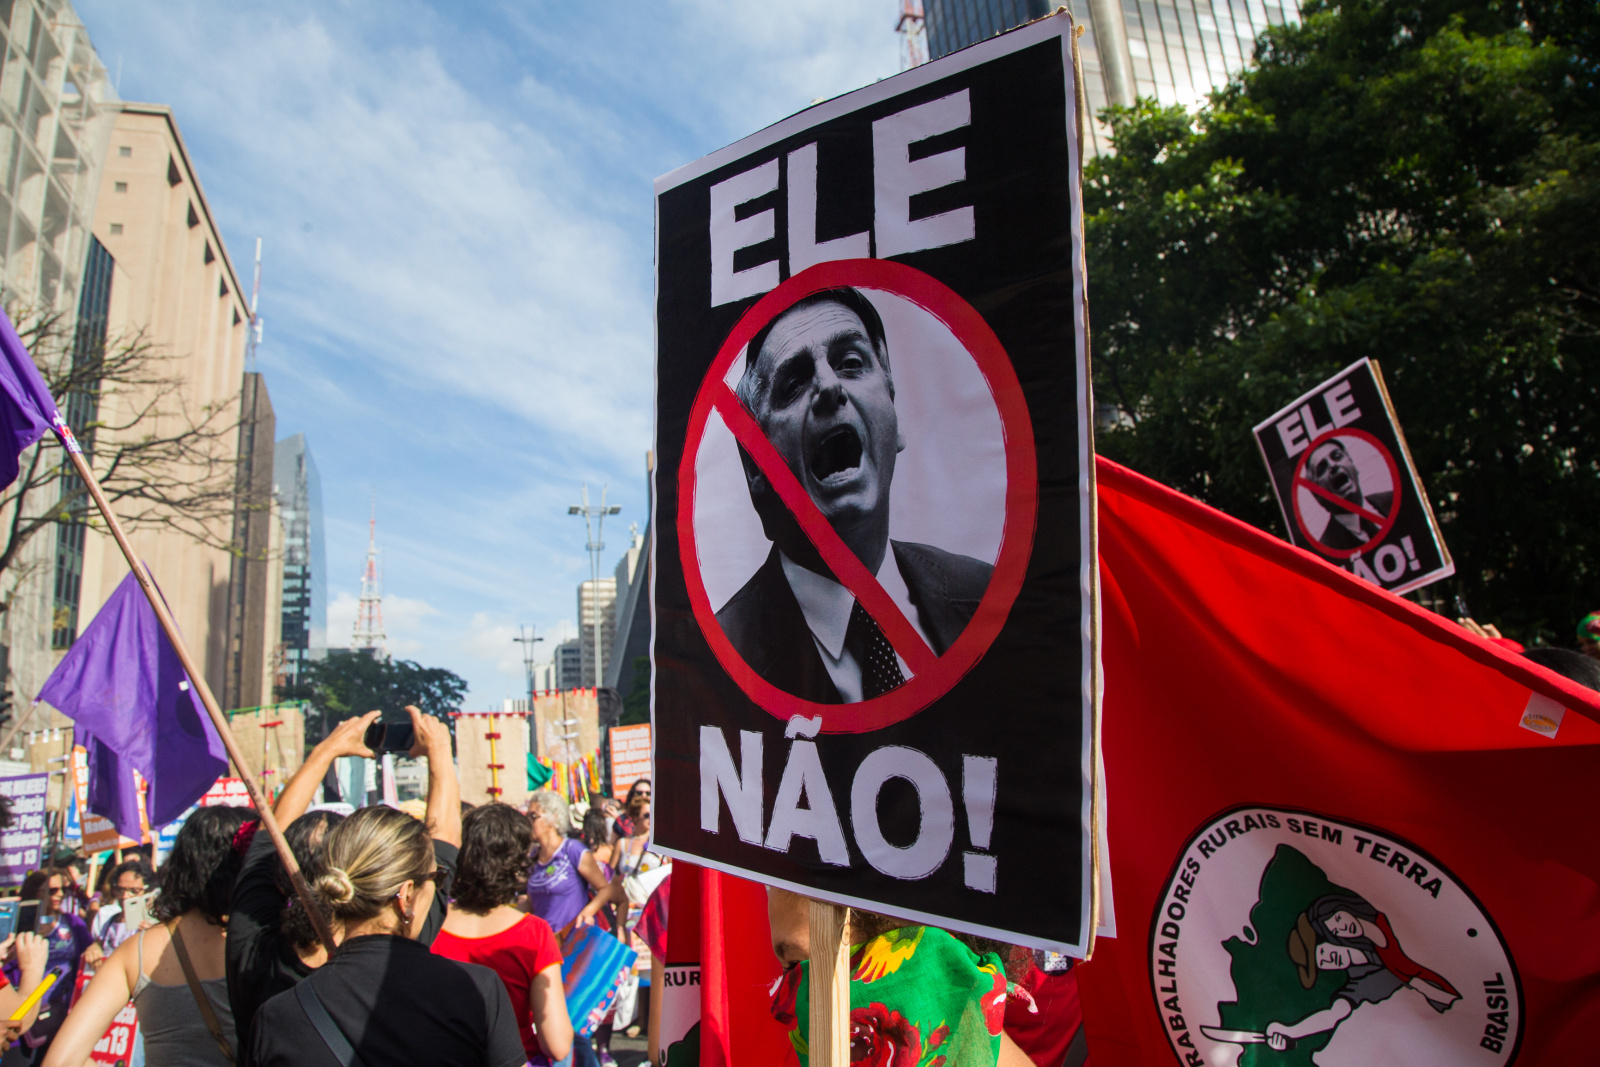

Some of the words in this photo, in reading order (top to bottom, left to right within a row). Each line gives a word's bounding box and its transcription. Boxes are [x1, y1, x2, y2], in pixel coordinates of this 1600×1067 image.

[710, 87, 976, 308] ELE
[1275, 379, 1362, 459] ELE
[1339, 535, 1421, 587] ÃO!
[84, 818, 116, 835] Hadd
[699, 714, 998, 895] NÃO!
[664, 970, 701, 988] RUR
[1158, 857, 1205, 1067] RABALHADORES
[1197, 813, 1281, 859] RURAIS
[1286, 818, 1342, 845] SEM
[1353, 835, 1443, 899] TERRA
[109, 1026, 130, 1056] 13
[1479, 972, 1509, 1054] BRASIL
